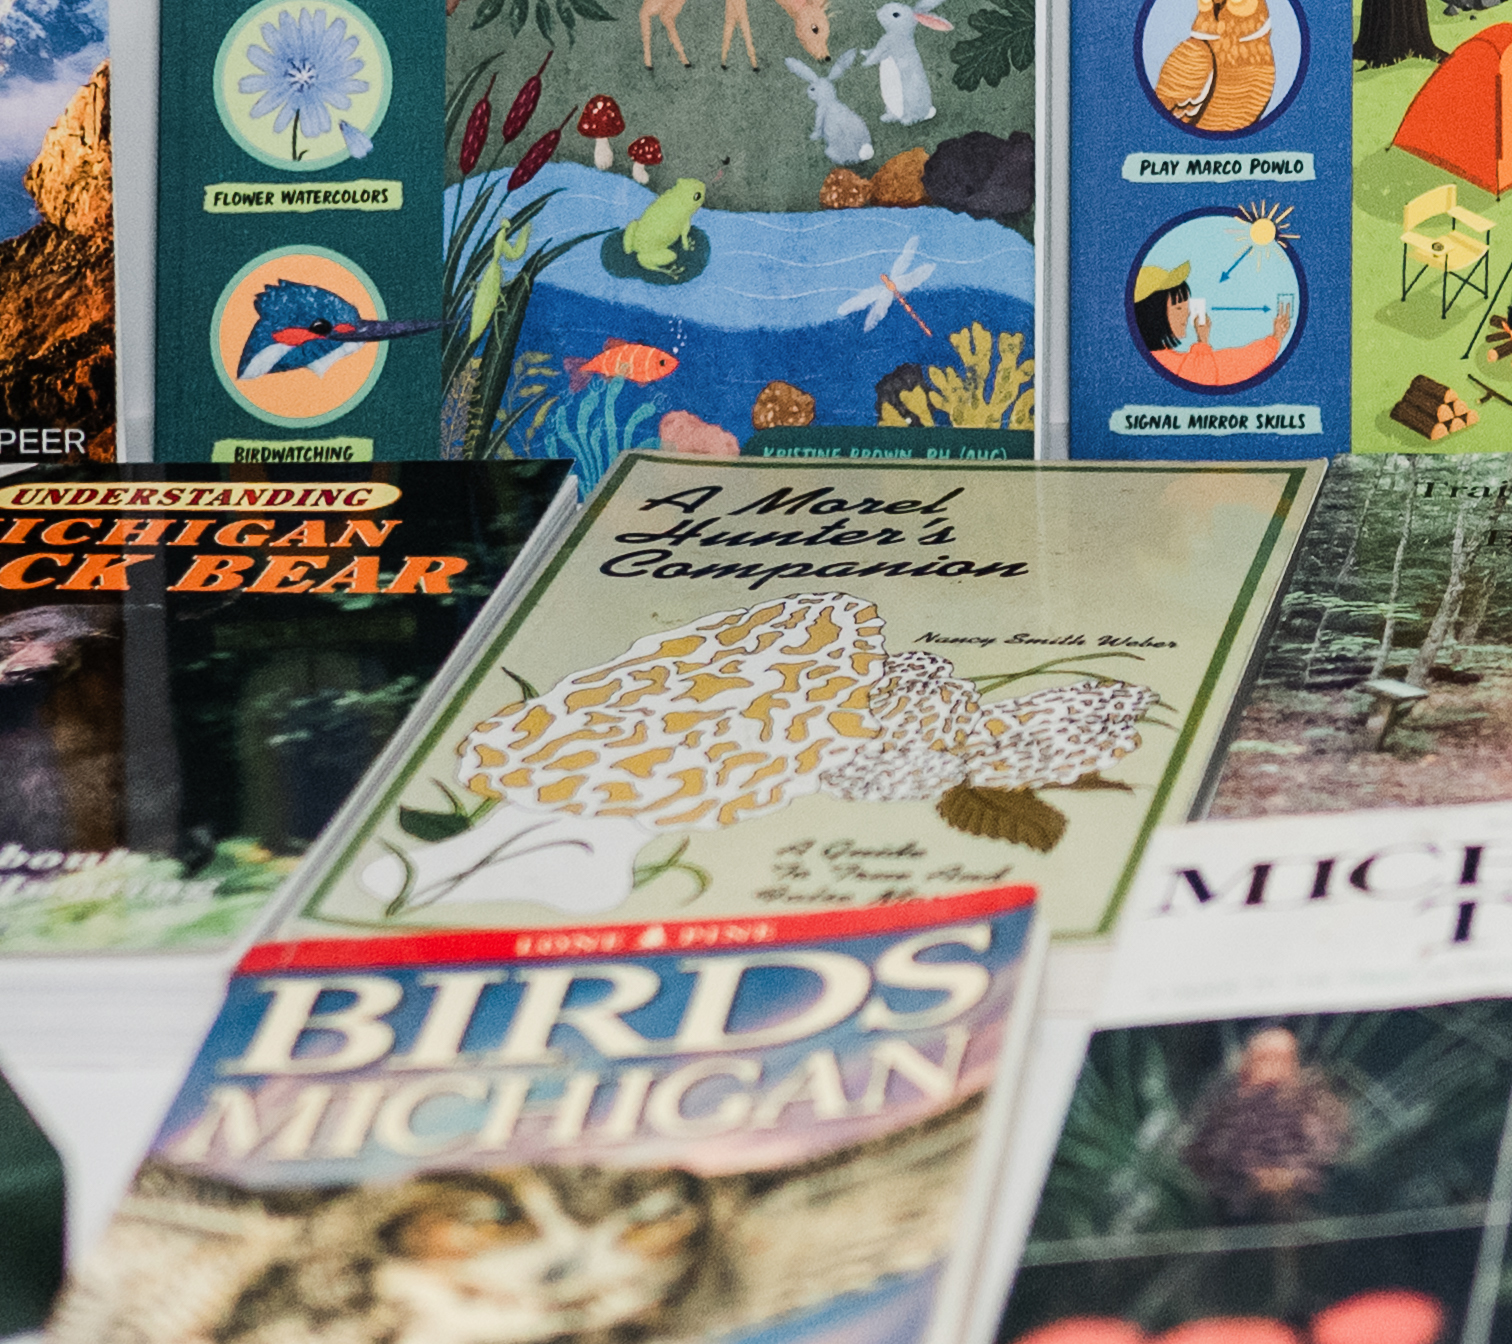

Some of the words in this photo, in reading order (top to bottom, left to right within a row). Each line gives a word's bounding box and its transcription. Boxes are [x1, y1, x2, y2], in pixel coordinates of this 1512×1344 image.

[1140, 159, 1180, 176] PLAY
[1186, 159, 1243, 175] MARCO
[1249, 158, 1304, 175] POWLO
[213, 191, 275, 207] FLOWER
[281, 188, 389, 205] WATERCOLORS
[1125, 414, 1181, 430] SIGNAL
[1187, 414, 1249, 430] MIRROR
[1256, 413, 1306, 429] SKILLS
[234, 445, 354, 463] BIRDWATCHING
[10, 487, 375, 509] UNDERSTANDING
[638, 485, 723, 516] A
[731, 487, 966, 518] Morel
[614, 518, 959, 549] Hunter's
[167, 554, 470, 595] BEAR
[600, 549, 1030, 590] Companion
[914, 629, 1000, 651] Nancy
[1006, 630, 1088, 648] Smith
[1096, 633, 1179, 650] Weber
[221, 922, 998, 1076] BIRDS
[180, 1029, 972, 1161] MICHIGAN
